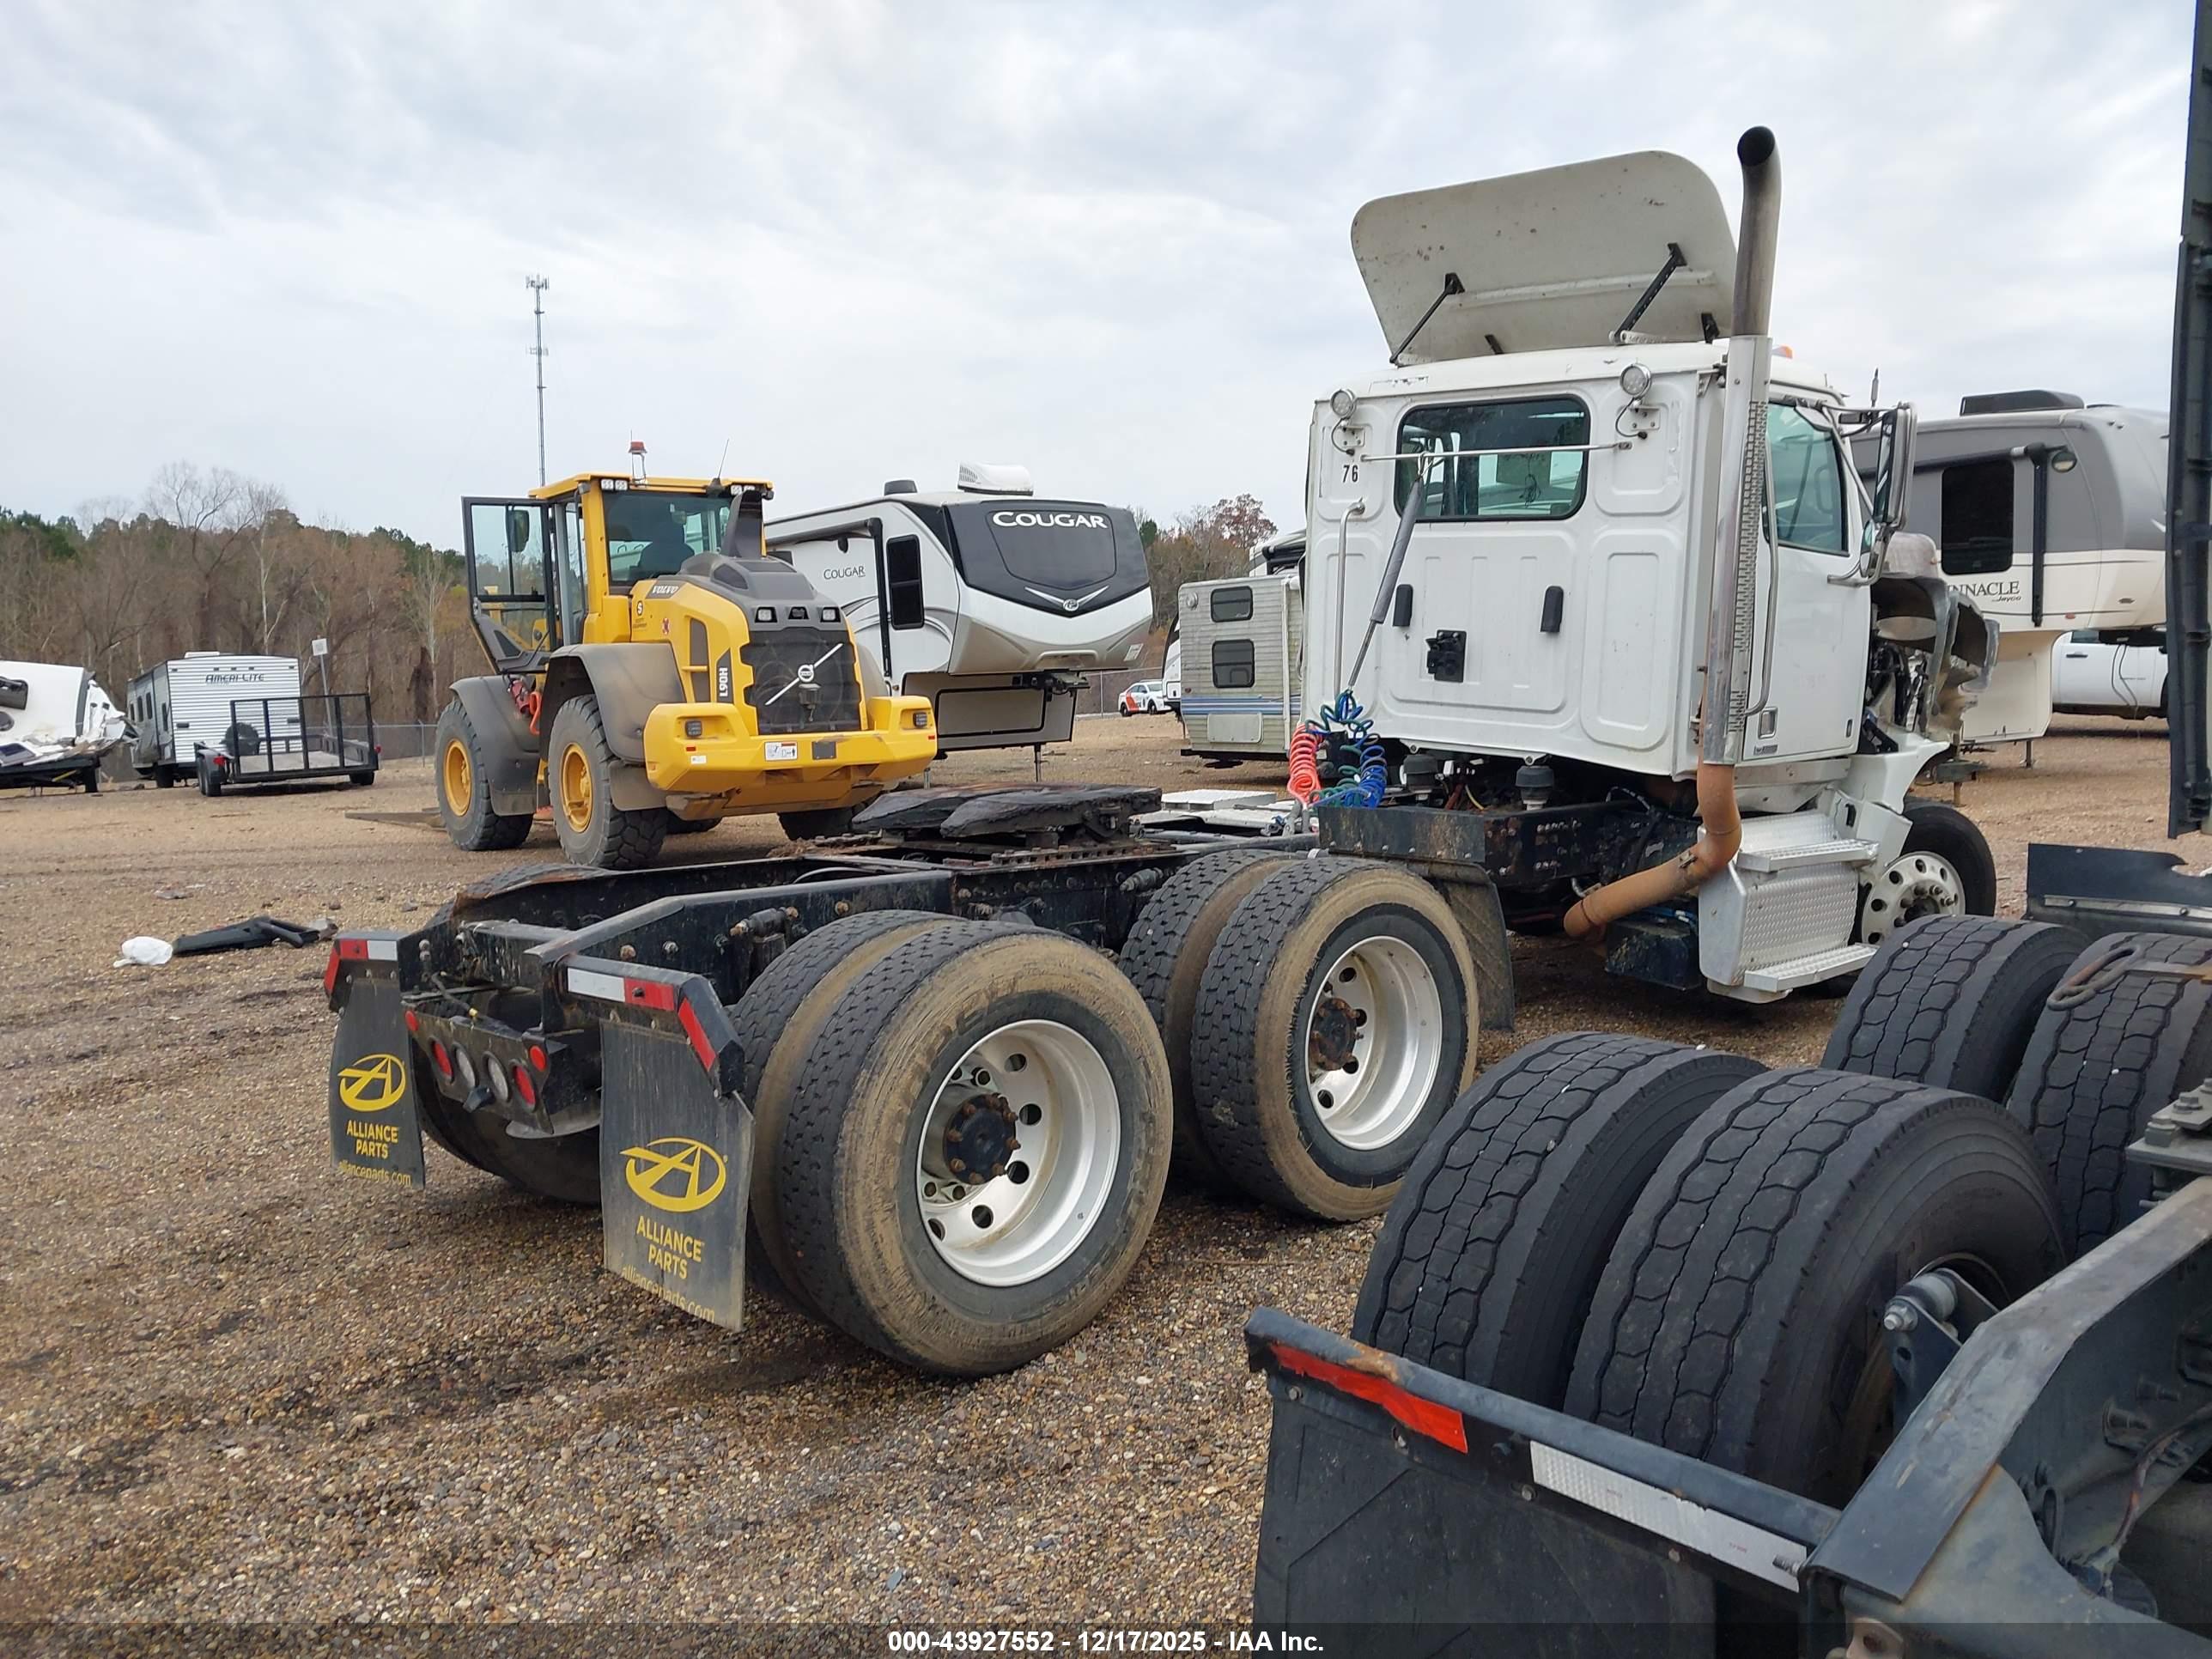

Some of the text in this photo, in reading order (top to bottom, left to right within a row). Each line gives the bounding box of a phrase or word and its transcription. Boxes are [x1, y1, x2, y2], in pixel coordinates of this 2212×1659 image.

[1342, 465, 1358, 483] 76
[993, 511, 1108, 529] COUGAR
[823, 565, 866, 580] COUGAR
[1947, 580, 2021, 597] INNACLE
[205, 672, 265, 684] AMERI-LITE
[719, 666, 729, 697] L90H
[346, 1119, 399, 1144] ALLIANCE
[356, 1139, 389, 1159] PARTS
[635, 1214, 703, 1262] ALLIANCE
[647, 1244, 688, 1279] PARTS
